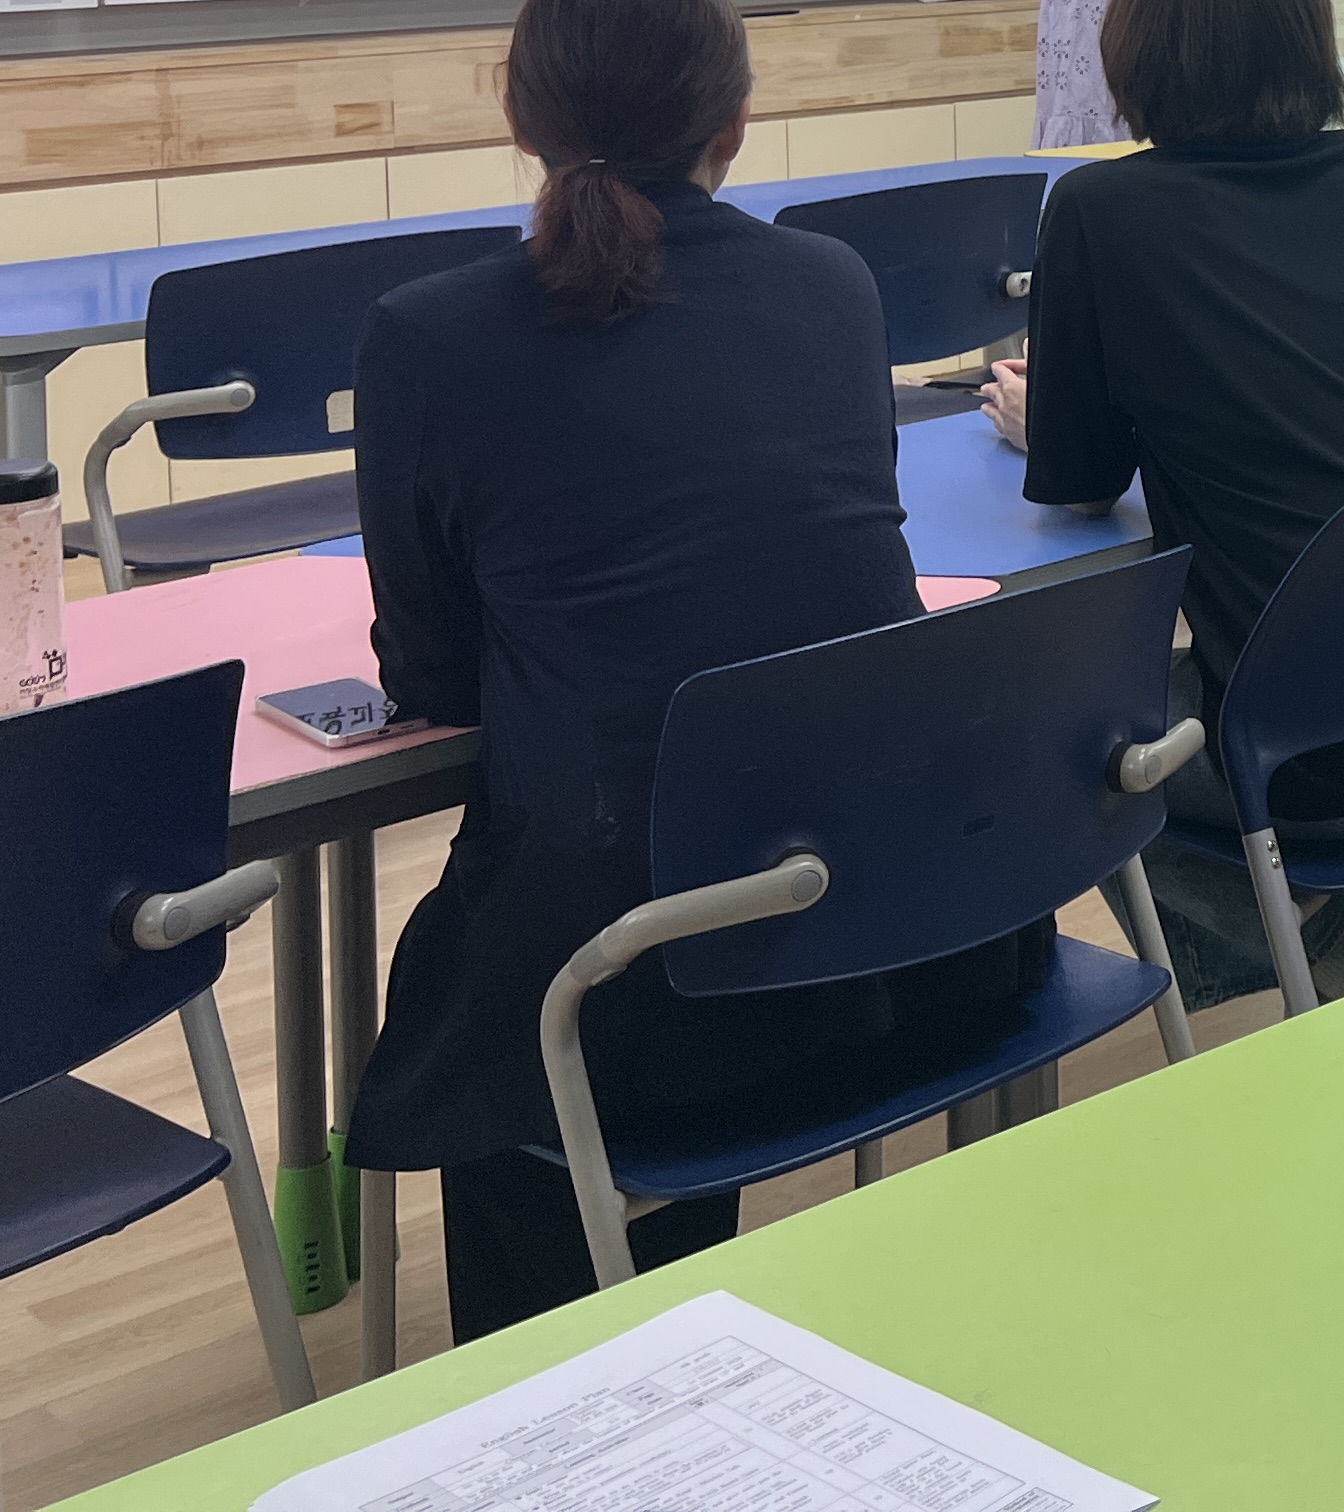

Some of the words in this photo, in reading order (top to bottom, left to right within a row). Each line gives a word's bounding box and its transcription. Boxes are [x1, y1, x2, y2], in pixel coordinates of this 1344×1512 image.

[480, 1425, 530, 1449] English
[530, 1401, 579, 1425] Lesson
[581, 1386, 611, 1402] Plan
